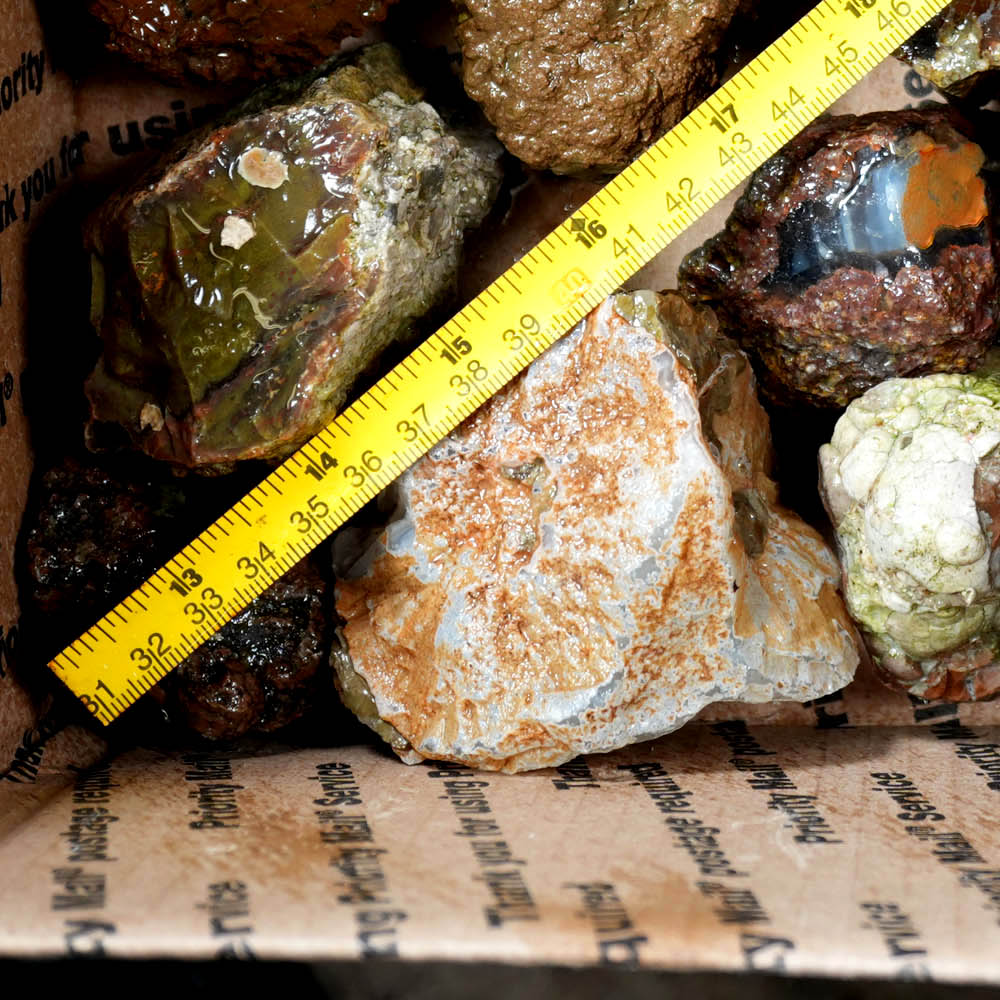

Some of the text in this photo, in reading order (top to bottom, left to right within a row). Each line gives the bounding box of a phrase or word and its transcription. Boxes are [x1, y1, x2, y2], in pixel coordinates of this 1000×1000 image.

[80, 679, 115, 715] 31
[130, 633, 172, 671] 32
[184, 587, 224, 625] 33
[236, 541, 277, 580] 34
[290, 494, 330, 534] 35
[343, 450, 383, 488] 36
[396, 403, 431, 443] 37
[450, 360, 488, 397] 38
[502, 314, 541, 351] 39
[612, 223, 646, 259] 41
[665, 177, 701, 213] 42
[718, 132, 752, 168] 43
[771, 86, 806, 122] 44
[824, 40, 858, 77] 45
[170, 567, 203, 597] 13
[304, 451, 339, 482] 14
[440, 336, 473, 366] 15
[574, 219, 608, 250] 16
[709, 103, 740, 134] 17
[869, 771, 946, 823] Service
